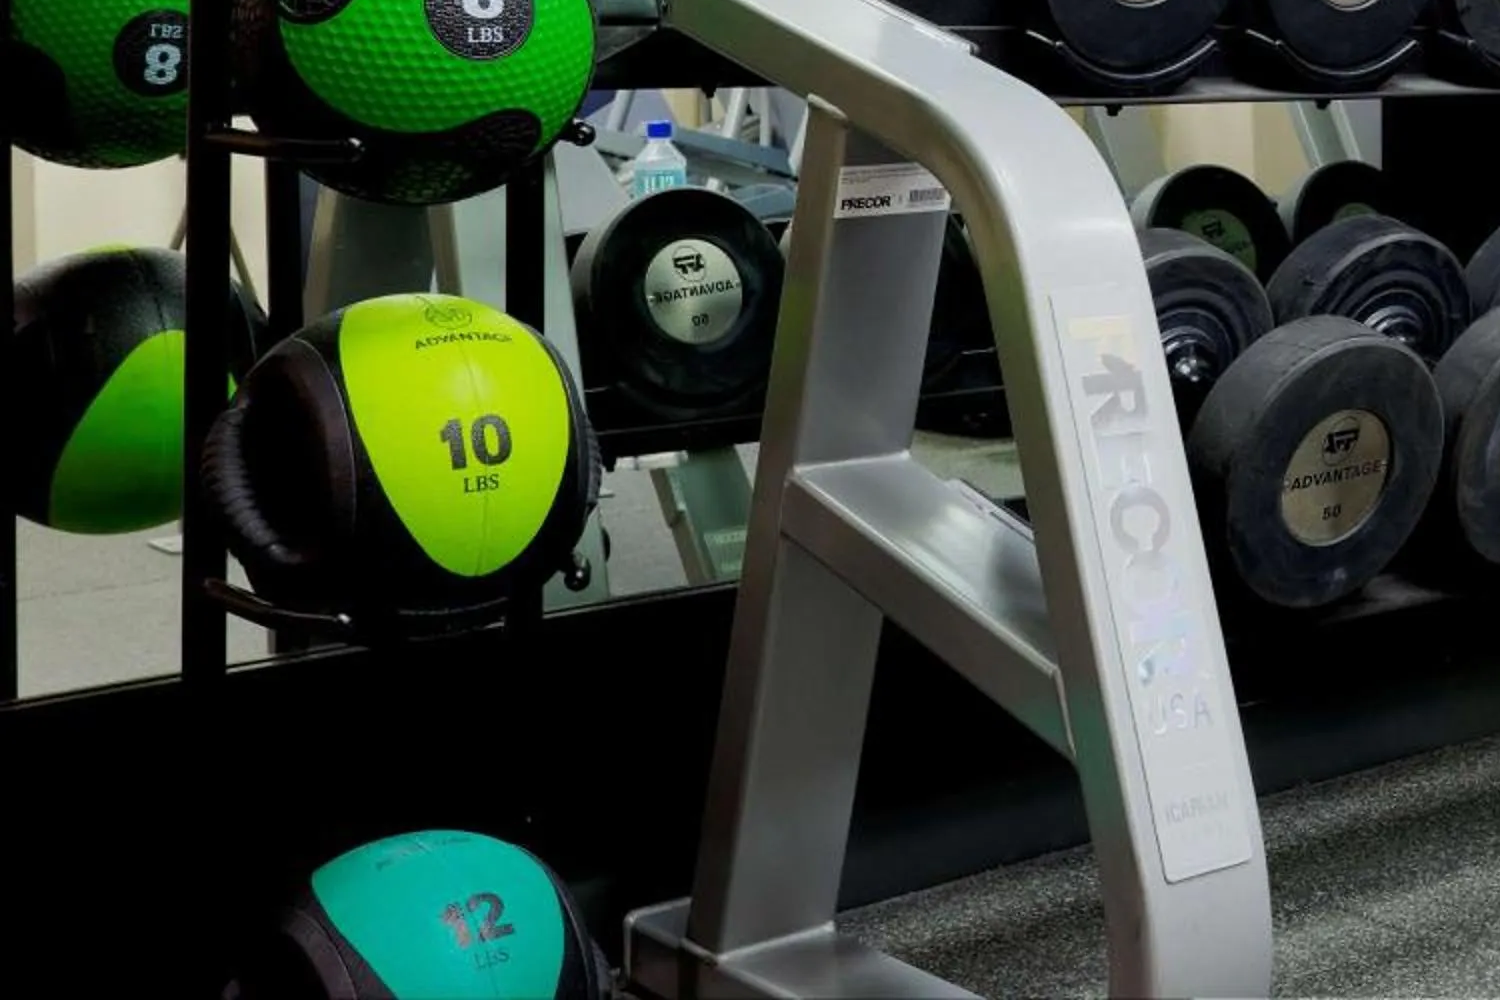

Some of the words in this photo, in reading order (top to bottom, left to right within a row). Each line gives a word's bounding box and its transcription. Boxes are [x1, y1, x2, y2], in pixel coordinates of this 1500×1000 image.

[466, 26, 504, 43] LBS
[840, 195, 891, 210] PRECOR
[415, 331, 513, 350] ADVANTAGE
[440, 413, 513, 471] 10
[463, 473, 500, 494] LBS
[1290, 461, 1381, 490] ADVANTAGE
[1322, 504, 1341, 520] 50
[440, 892, 515, 948] 12
[473, 949, 510, 971] LBS
